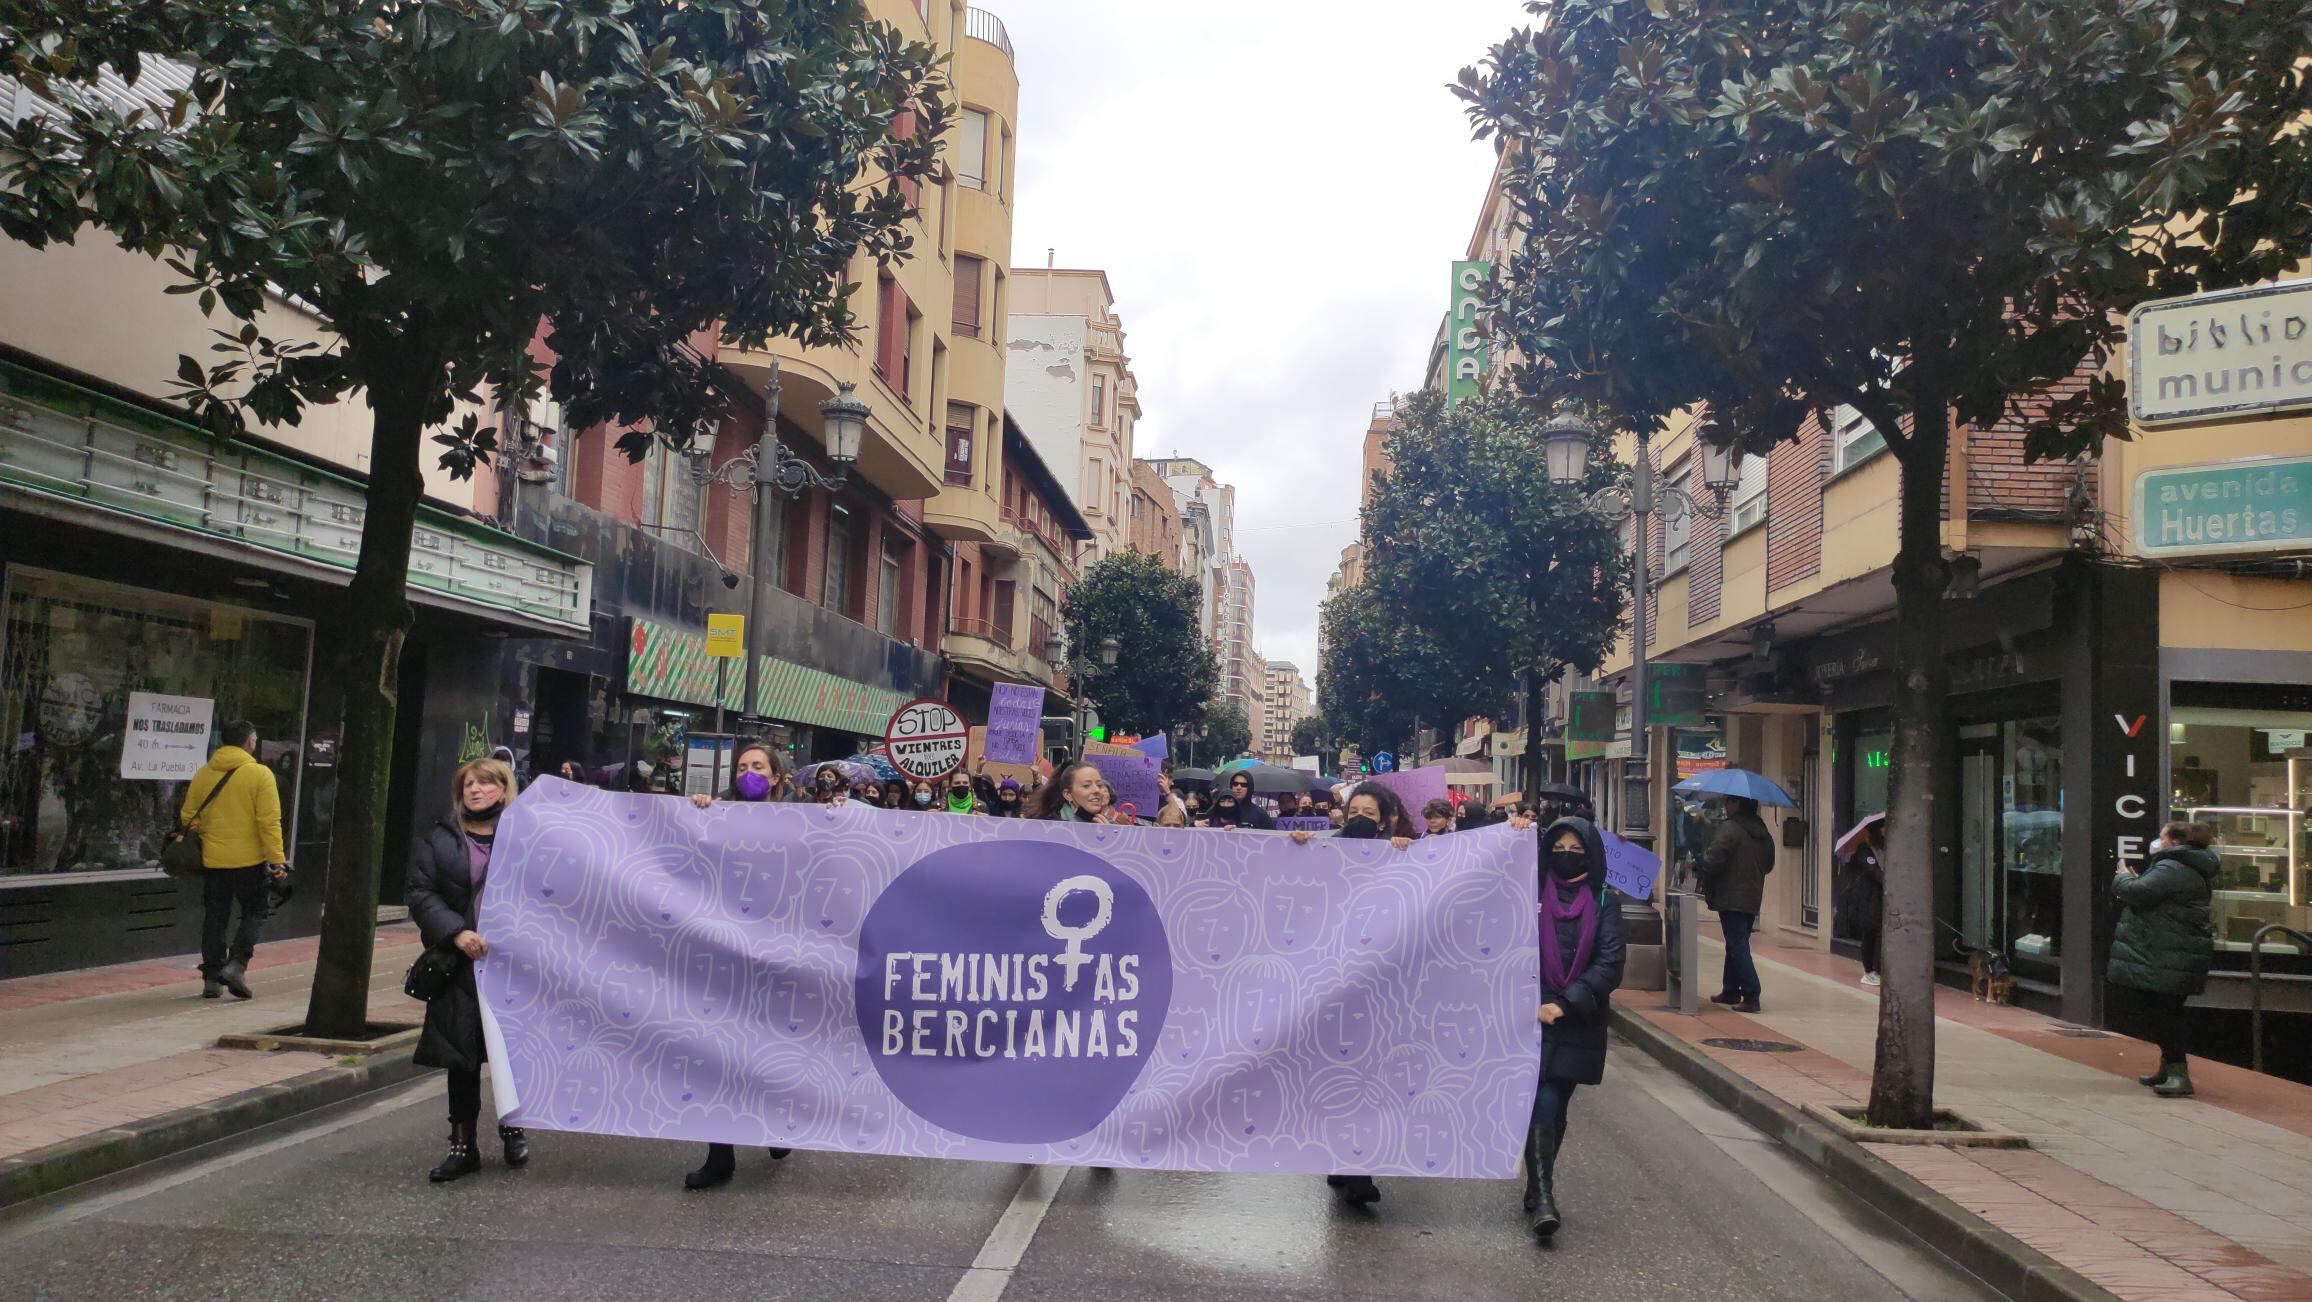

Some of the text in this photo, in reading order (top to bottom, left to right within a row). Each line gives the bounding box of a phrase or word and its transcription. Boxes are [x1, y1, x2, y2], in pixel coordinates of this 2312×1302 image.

[2158, 310, 2307, 358] biblio
[2160, 471, 2299, 504] avenida
[2161, 503, 2298, 544] Huertas
[151, 702, 191, 715] FARMACIA
[897, 708, 956, 735] STOP
[133, 718, 205, 735] NOS TRASLADAMOS
[138, 739, 149, 748] 40
[895, 740, 962, 755] VIENTRES
[131, 761, 144, 771] Av.
[148, 761, 157, 771] La
[161, 762, 186, 772] Puebla
[899, 752, 960, 777] ALQUILER
[1109, 760, 1138, 770] TENGO
[2115, 714, 2147, 860] VICE
[883, 932, 1140, 1001] FEMINISTAS
[882, 1009, 1139, 1058] BERCIANAS
